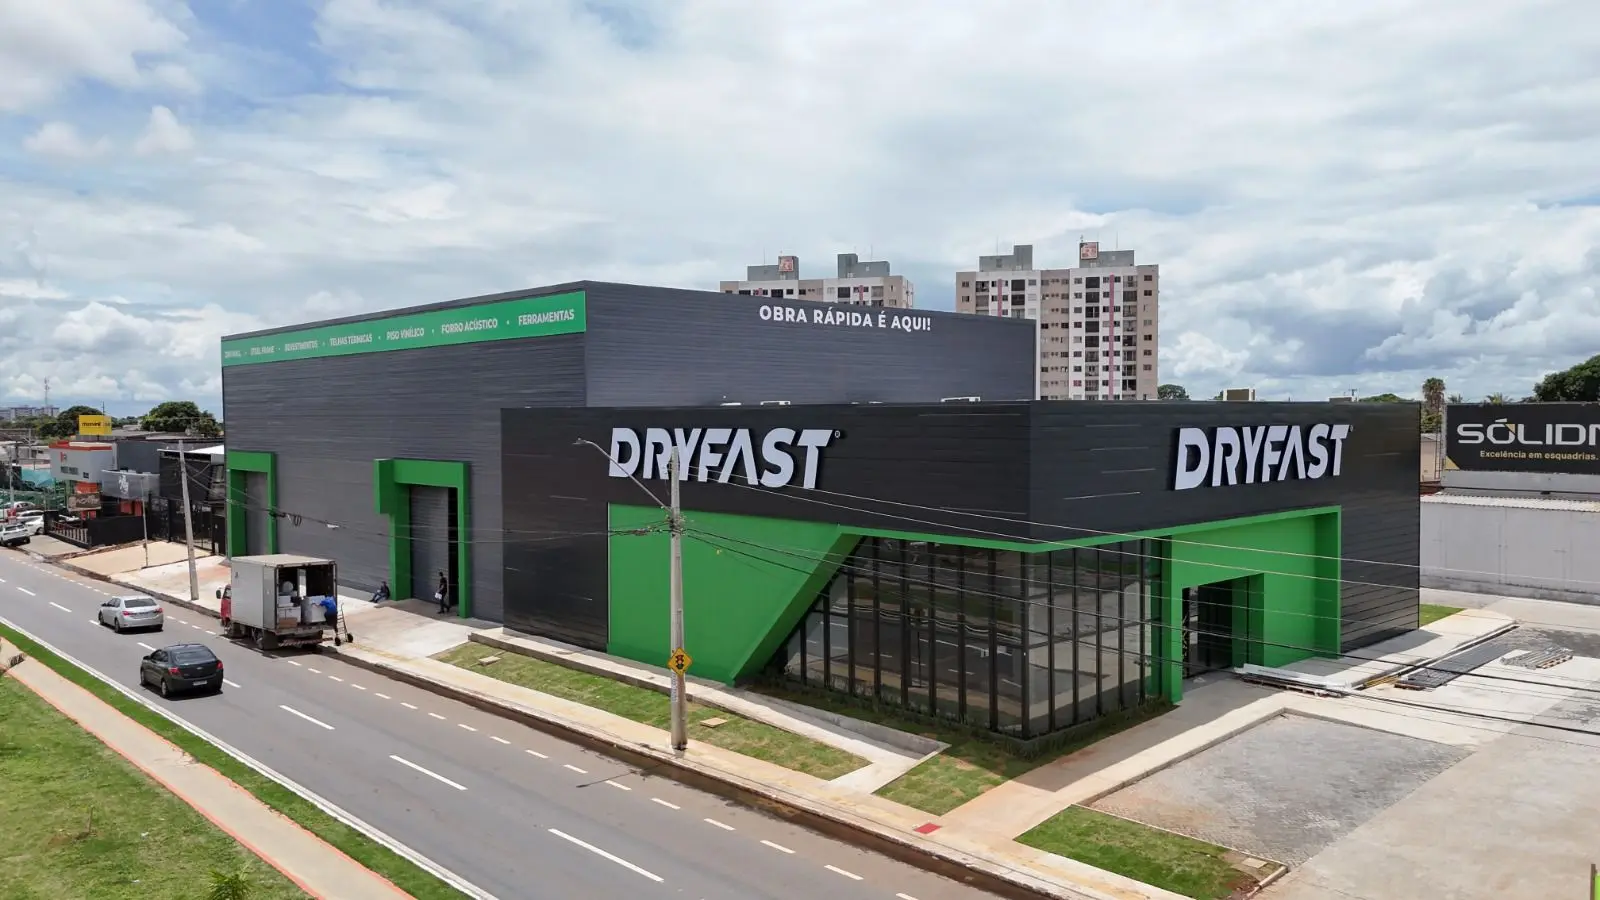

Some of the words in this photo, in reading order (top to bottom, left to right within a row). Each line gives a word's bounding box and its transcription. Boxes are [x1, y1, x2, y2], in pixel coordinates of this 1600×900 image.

[386, 330, 400, 341] PISO
[441, 322, 463, 334] FORRO
[464, 317, 498, 332] ACÚSTICO
[518, 308, 575, 326] FERRAMENTAS
[759, 305, 808, 323] OBRA
[813, 307, 873, 328] RÁPIDA
[877, 310, 887, 328] É
[891, 315, 931, 333] AQUI!
[608, 427, 833, 489] DRYFAST
[1174, 423, 1350, 490] DRYFAST
[1480, 450, 1527, 459] Excelência
[1528, 451, 1542, 459] em
[1544, 450, 1599, 461] esquadrias.
